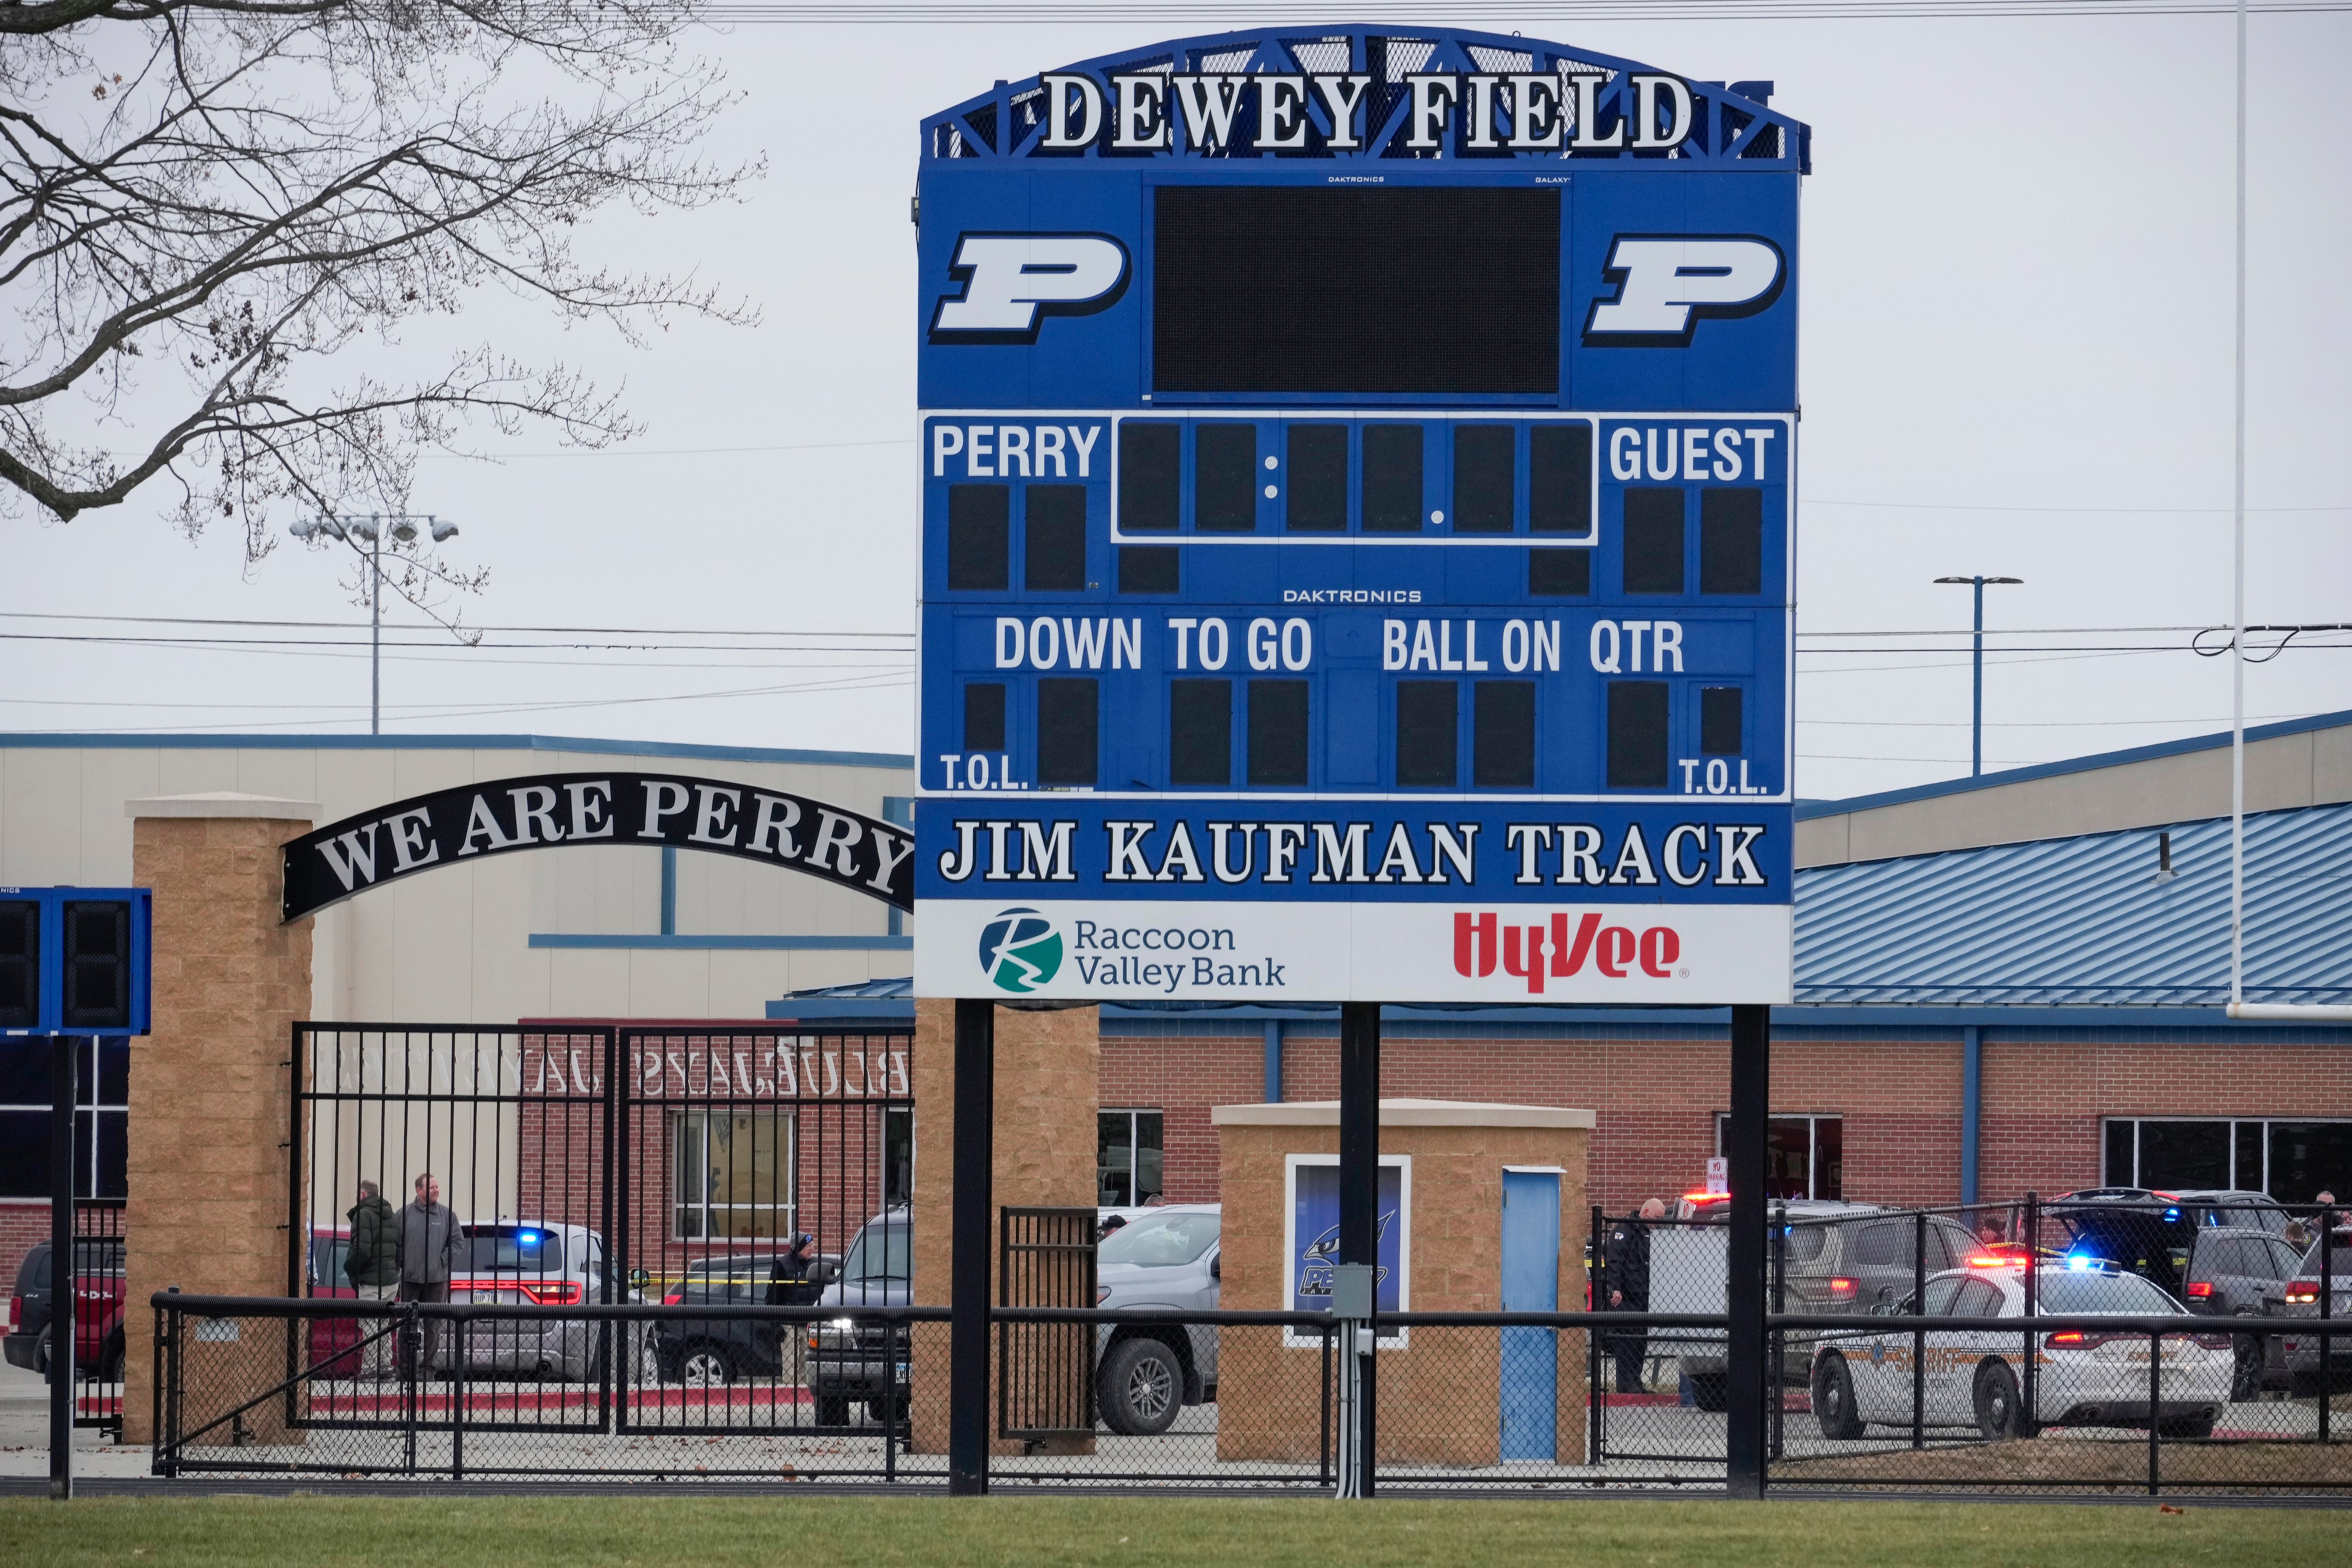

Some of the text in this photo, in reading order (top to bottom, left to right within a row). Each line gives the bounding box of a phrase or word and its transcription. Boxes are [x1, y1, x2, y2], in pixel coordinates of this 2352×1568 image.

[1042, 74, 1692, 148] DEWEY FIELD
[933, 425, 1101, 477] PERRY
[1610, 427, 1775, 481] GUEST
[1283, 590, 1422, 603] DAKTRONICS
[995, 616, 1142, 670] DOWN
[1168, 617, 1312, 671] TO GO
[1383, 619, 1560, 672] BALL ON
[1590, 619, 1684, 674] QTR
[940, 754, 1028, 790] T.O.L.
[1678, 758, 1767, 795] T.O.L.
[315, 780, 915, 895] WE ARE PERRY
[940, 822, 1764, 885] JIM KAUFMAN TRACK
[1074, 920, 1236, 951] Raccoon
[1074, 956, 1286, 994] Valley Bank
[1713, 1162, 1721, 1172] NO
[474, 1295, 485, 1303] HUP
[1896, 1347, 1960, 1373] SHRIFF
[2128, 1351, 2178, 1362] SHEIFF
